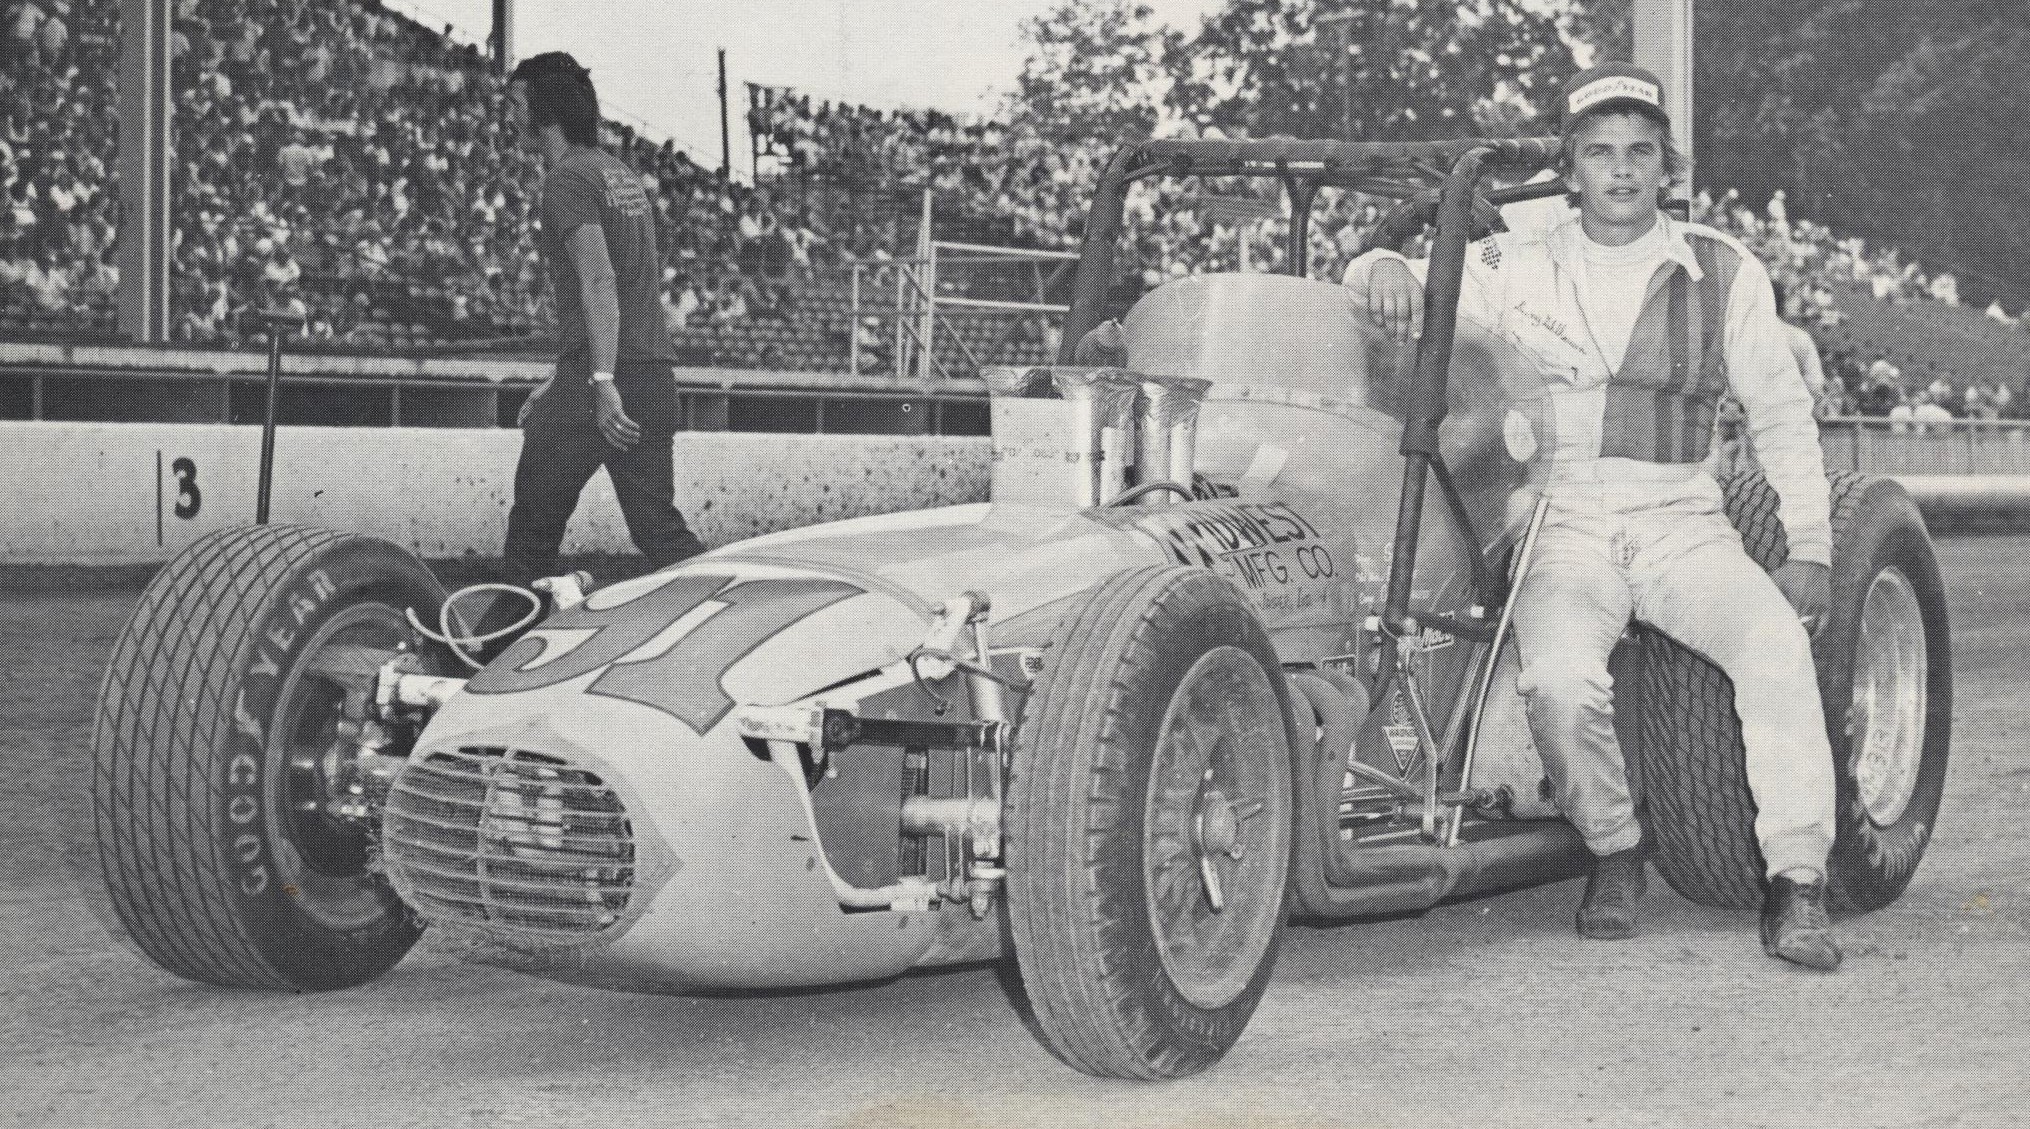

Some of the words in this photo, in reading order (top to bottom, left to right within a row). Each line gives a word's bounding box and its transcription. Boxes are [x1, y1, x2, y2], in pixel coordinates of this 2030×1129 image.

[1168, 501, 1320, 569] MIDWEST
[1232, 550, 1295, 590] MFG.
[1296, 544, 1340, 580] CO.
[463, 574, 870, 738] 91
